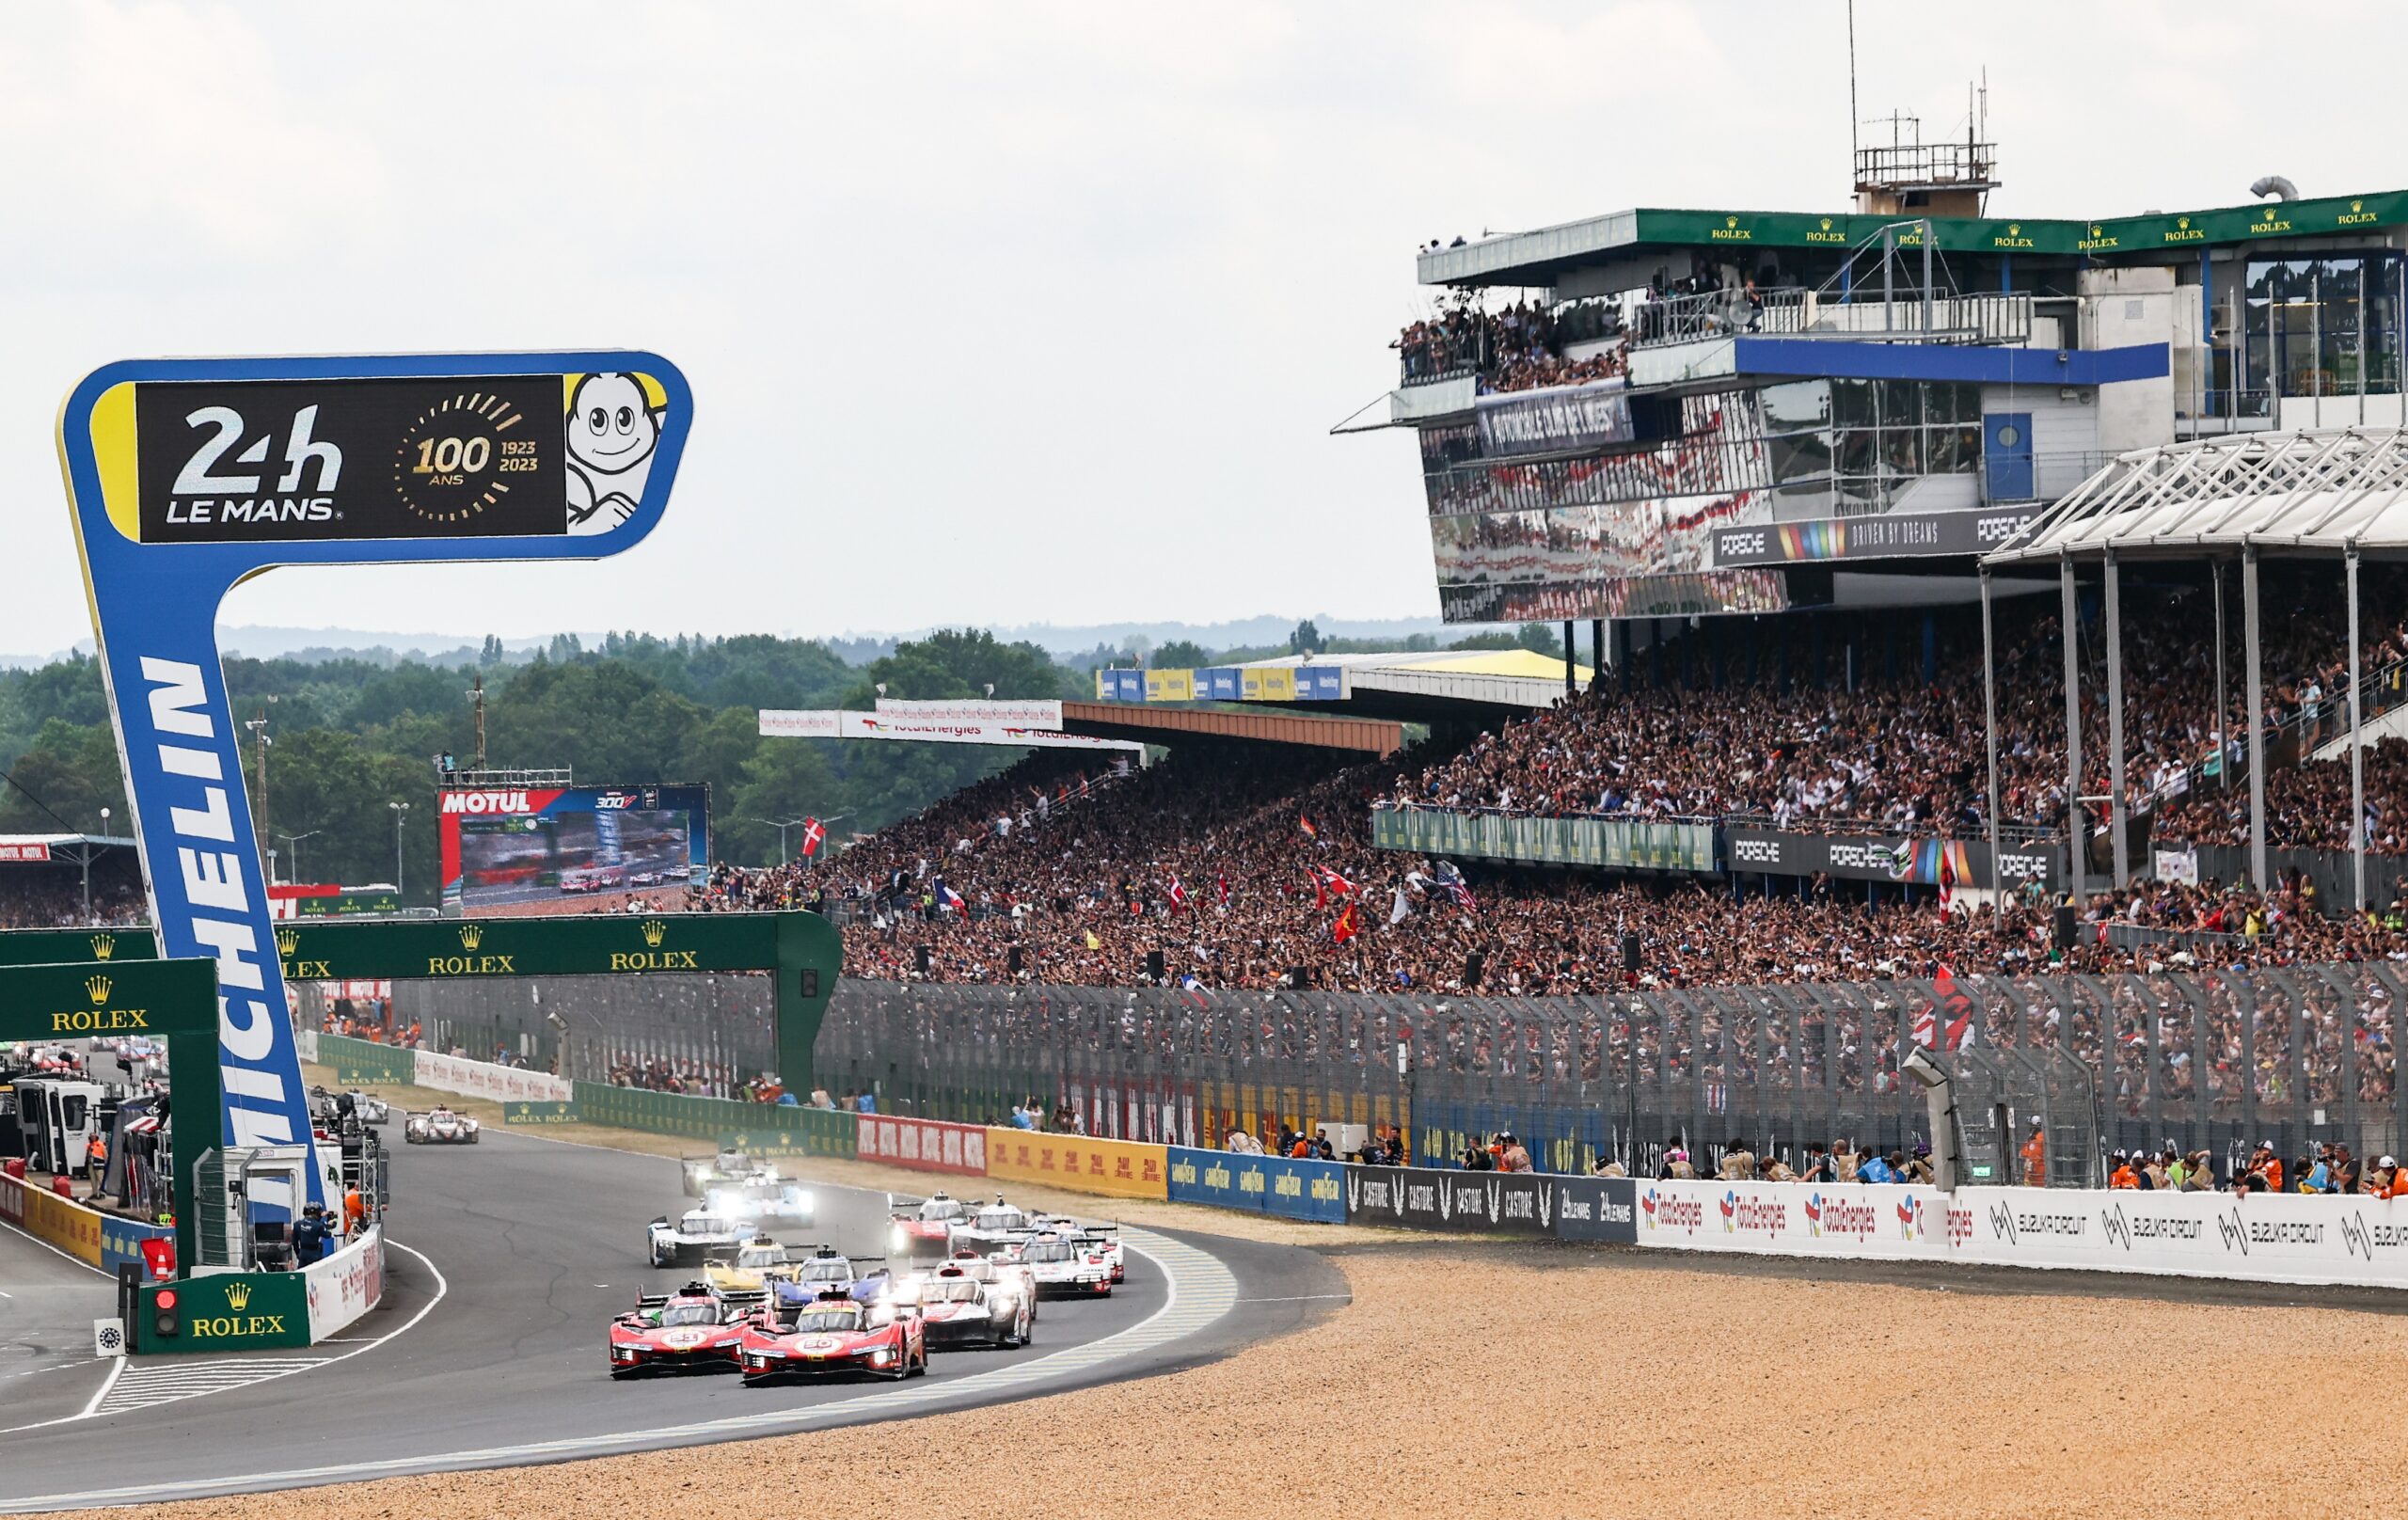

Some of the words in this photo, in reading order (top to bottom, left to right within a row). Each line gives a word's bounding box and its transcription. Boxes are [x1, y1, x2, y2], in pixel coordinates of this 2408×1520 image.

[2251, 220, 2291, 233] ROLEX
[2338, 212, 2377, 225] ROLEX
[1712, 230, 1751, 240] ROLEX
[1806, 232, 1846, 242] ROLEX
[1899, 235, 1940, 245] ROLX
[1994, 237, 2034, 247] ROLEX
[2078, 237, 2118, 250] ROLEX
[2164, 229, 2205, 242] ROLEX
[170, 403, 344, 496] 24h
[412, 435, 491, 474] 100
[500, 441, 536, 455] 1923
[499, 457, 539, 472] 2023
[428, 474, 465, 485] ANS
[166, 499, 215, 524] LE
[220, 498, 333, 523] MANS
[1852, 523, 1884, 547] DRIVEN
[1889, 522, 1898, 545] BY
[1903, 521, 1938, 545] DREAMS
[1978, 515, 2031, 542] PORSCHE
[1720, 532, 1765, 557] PORSCHE
[442, 792, 531, 814] MOTUL
[1735, 840, 1780, 863] PORSCHE
[280, 960, 332, 978] LEX
[428, 955, 515, 974] ROLEX
[610, 950, 697, 971] ROLEX
[52, 1009, 149, 1031] ROLEX
[1364, 1180, 1388, 1209] CASTORE
[1409, 1184, 1434, 1211] CASTORE
[1457, 1187, 1482, 1215] CASTORE
[1505, 1190, 1533, 1219] CASTORE
[1656, 1193, 1703, 1236] TotalEnergies
[1735, 1195, 1786, 1240] TotalEnergies
[1821, 1197, 1876, 1243] TotalEnergies
[2020, 1213, 2052, 1234] SUZUKA
[2054, 1215, 2087, 1236] CIRCUIT
[2133, 1216, 2167, 1238] SUZUKA
[2170, 1218, 2203, 1240] CIRCUIT
[2251, 1222, 2288, 1243] SUZUKA
[2289, 1223, 2324, 1244] CIRCUIT
[192, 1315, 286, 1338] ROLEX
[803, 1338, 833, 1349] 50
